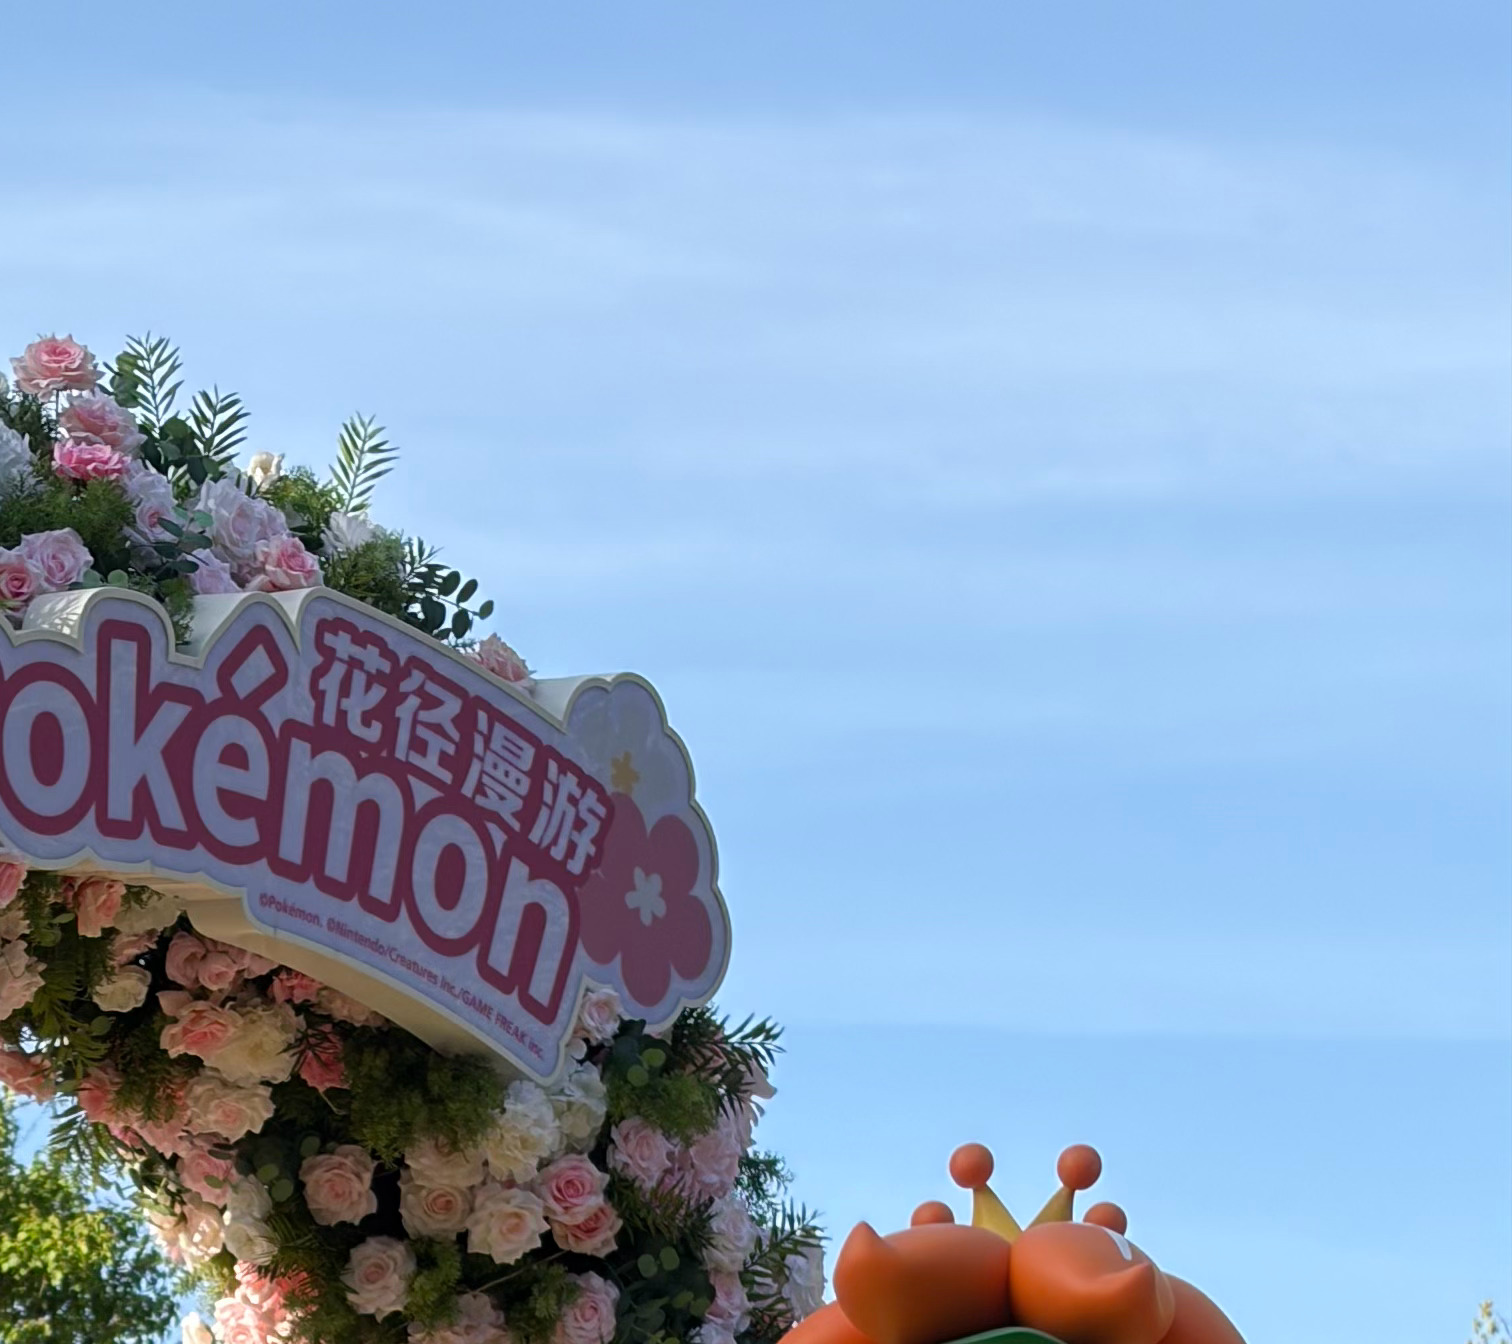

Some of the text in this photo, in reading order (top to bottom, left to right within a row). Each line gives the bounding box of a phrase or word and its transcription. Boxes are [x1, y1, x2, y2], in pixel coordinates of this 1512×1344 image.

[318, 630, 607, 876] 花径漫游
[495, 1011, 527, 1045] FREAK
